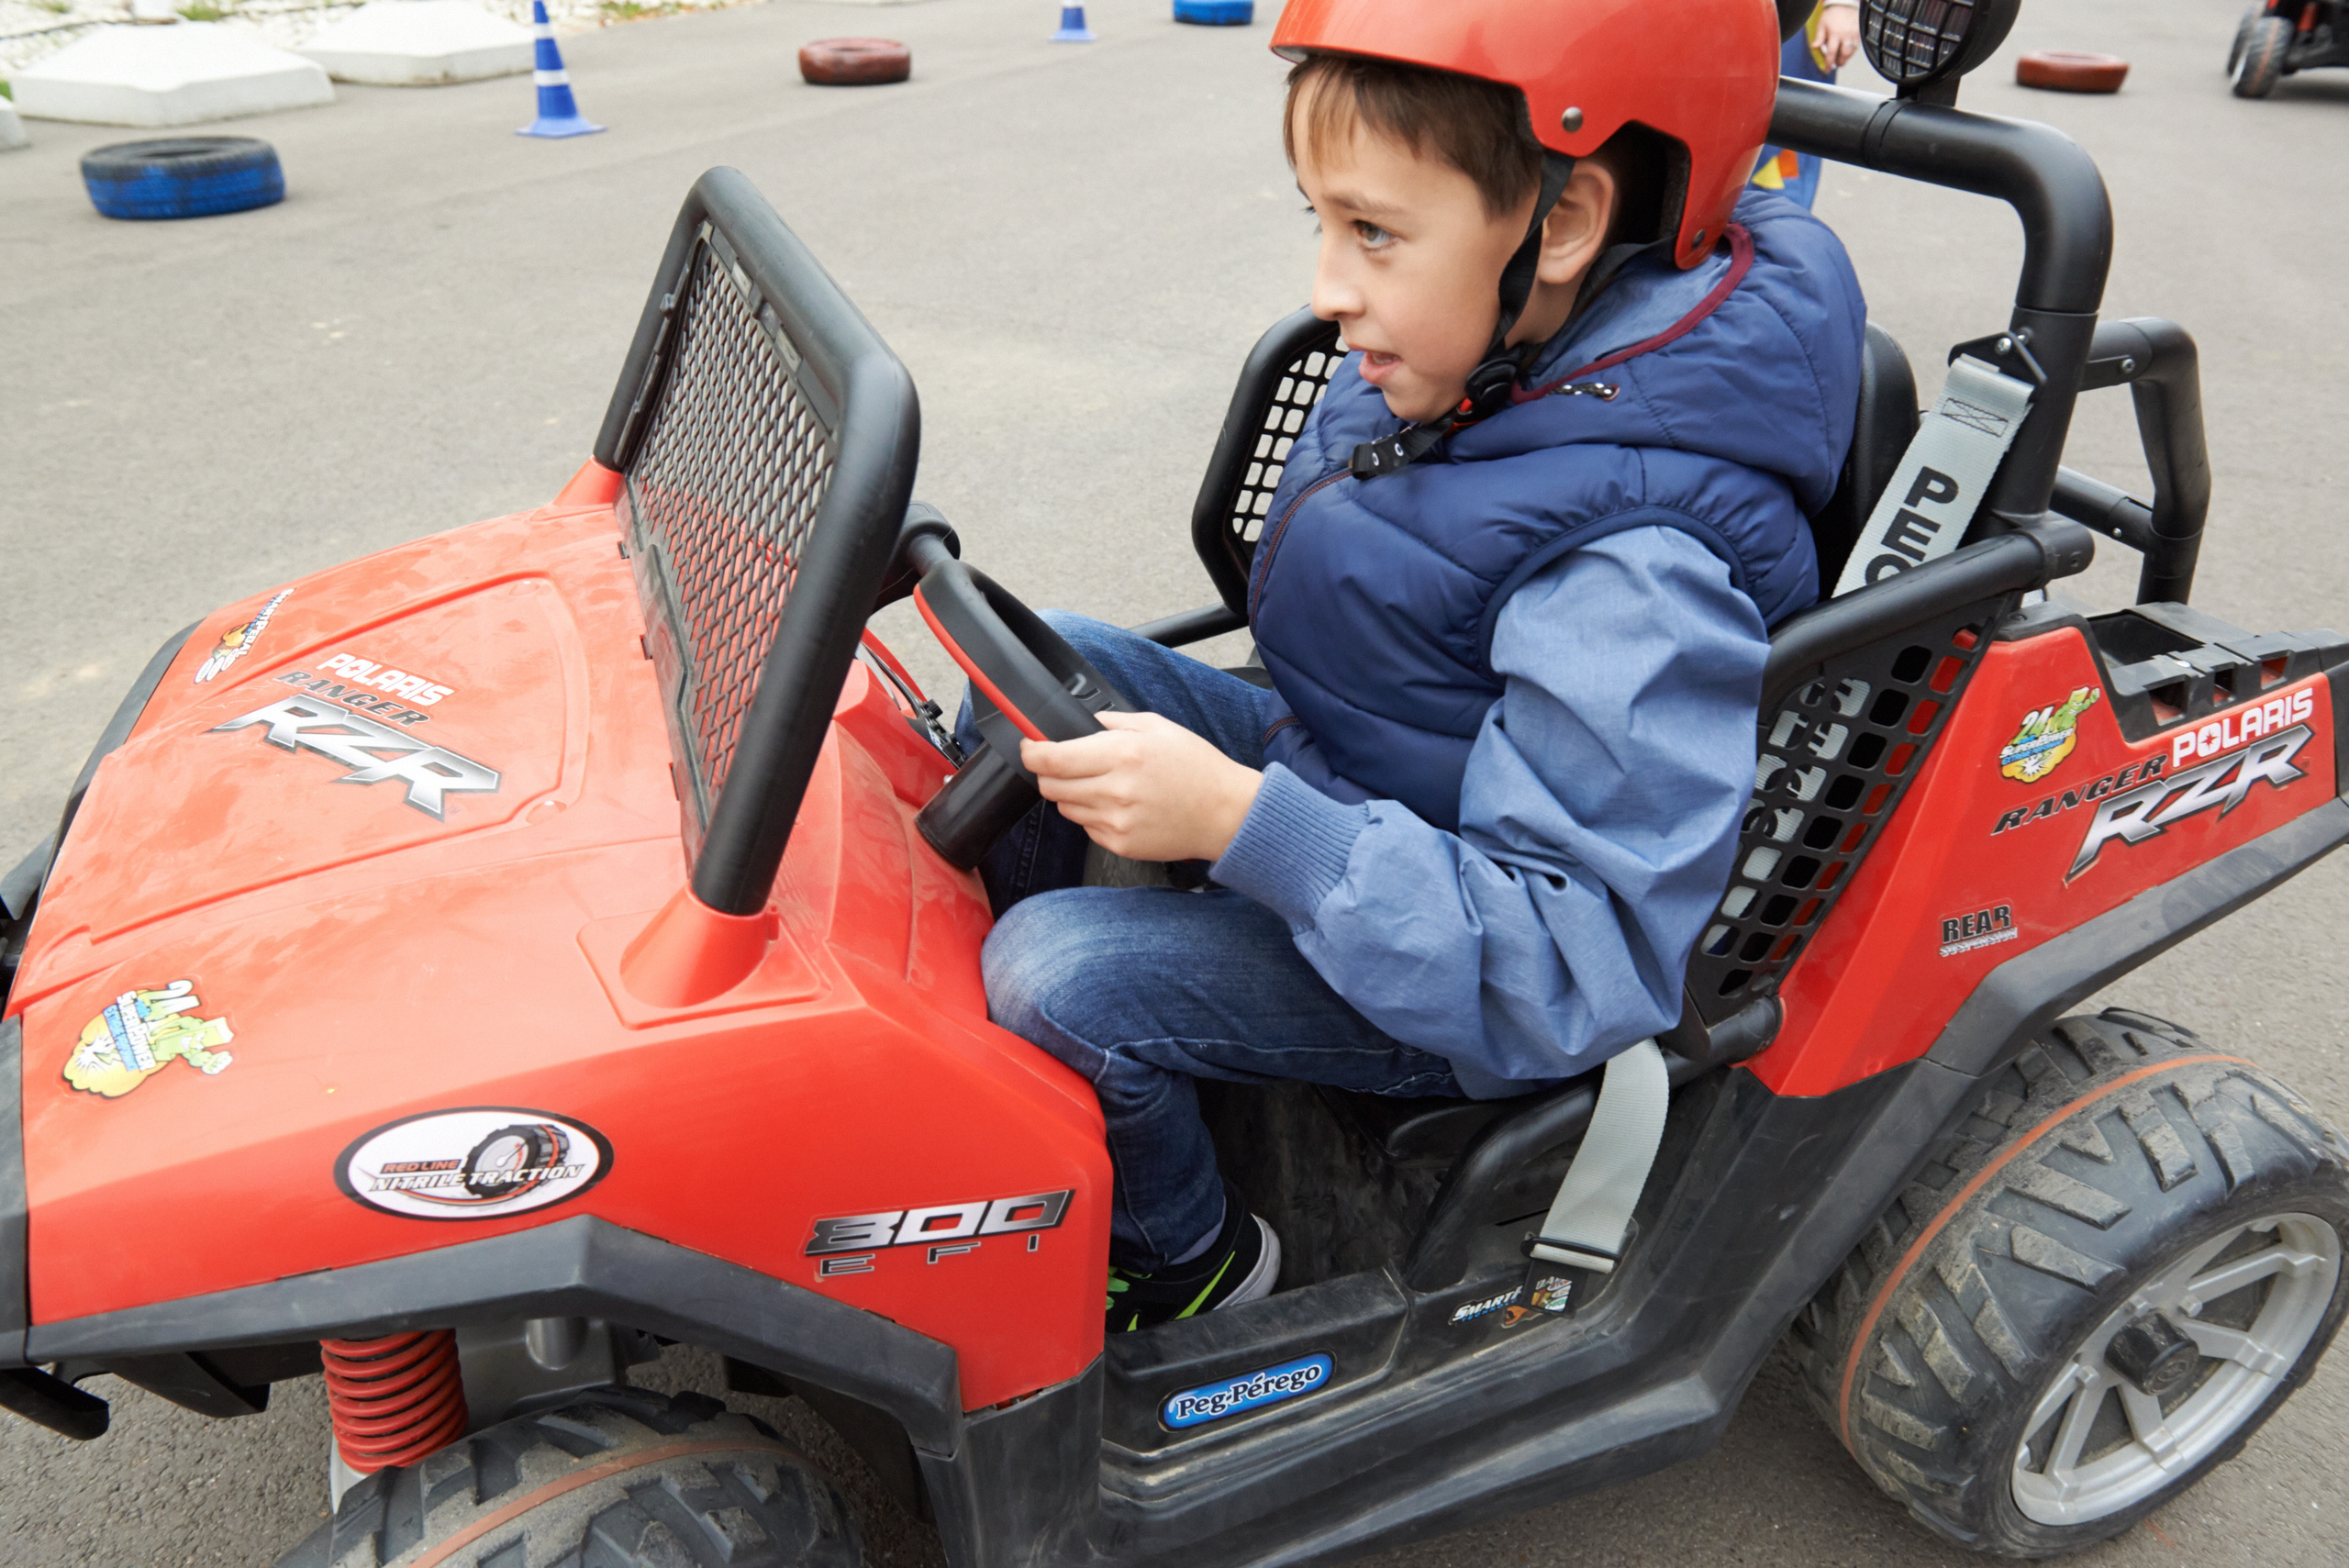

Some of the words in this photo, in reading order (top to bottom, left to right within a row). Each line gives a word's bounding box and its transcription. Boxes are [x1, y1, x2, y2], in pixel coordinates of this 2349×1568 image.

[274, 671, 431, 728] RANGER
[317, 652, 455, 706] POLARIS
[2011, 705, 2054, 745] 24
[2172, 687, 2313, 768] POLARIS
[207, 693, 502, 822] RZR
[1989, 754, 2168, 836] RANGER
[2063, 724, 2315, 883] RZR
[1942, 905, 2011, 944] REAR
[138, 979, 202, 1025] 24
[369, 1173, 466, 1191] NITRILE
[469, 1163, 584, 1185] TRACTION
[805, 1189, 1076, 1257] 800
[1175, 1363, 1321, 1419] Peg-Pérego
